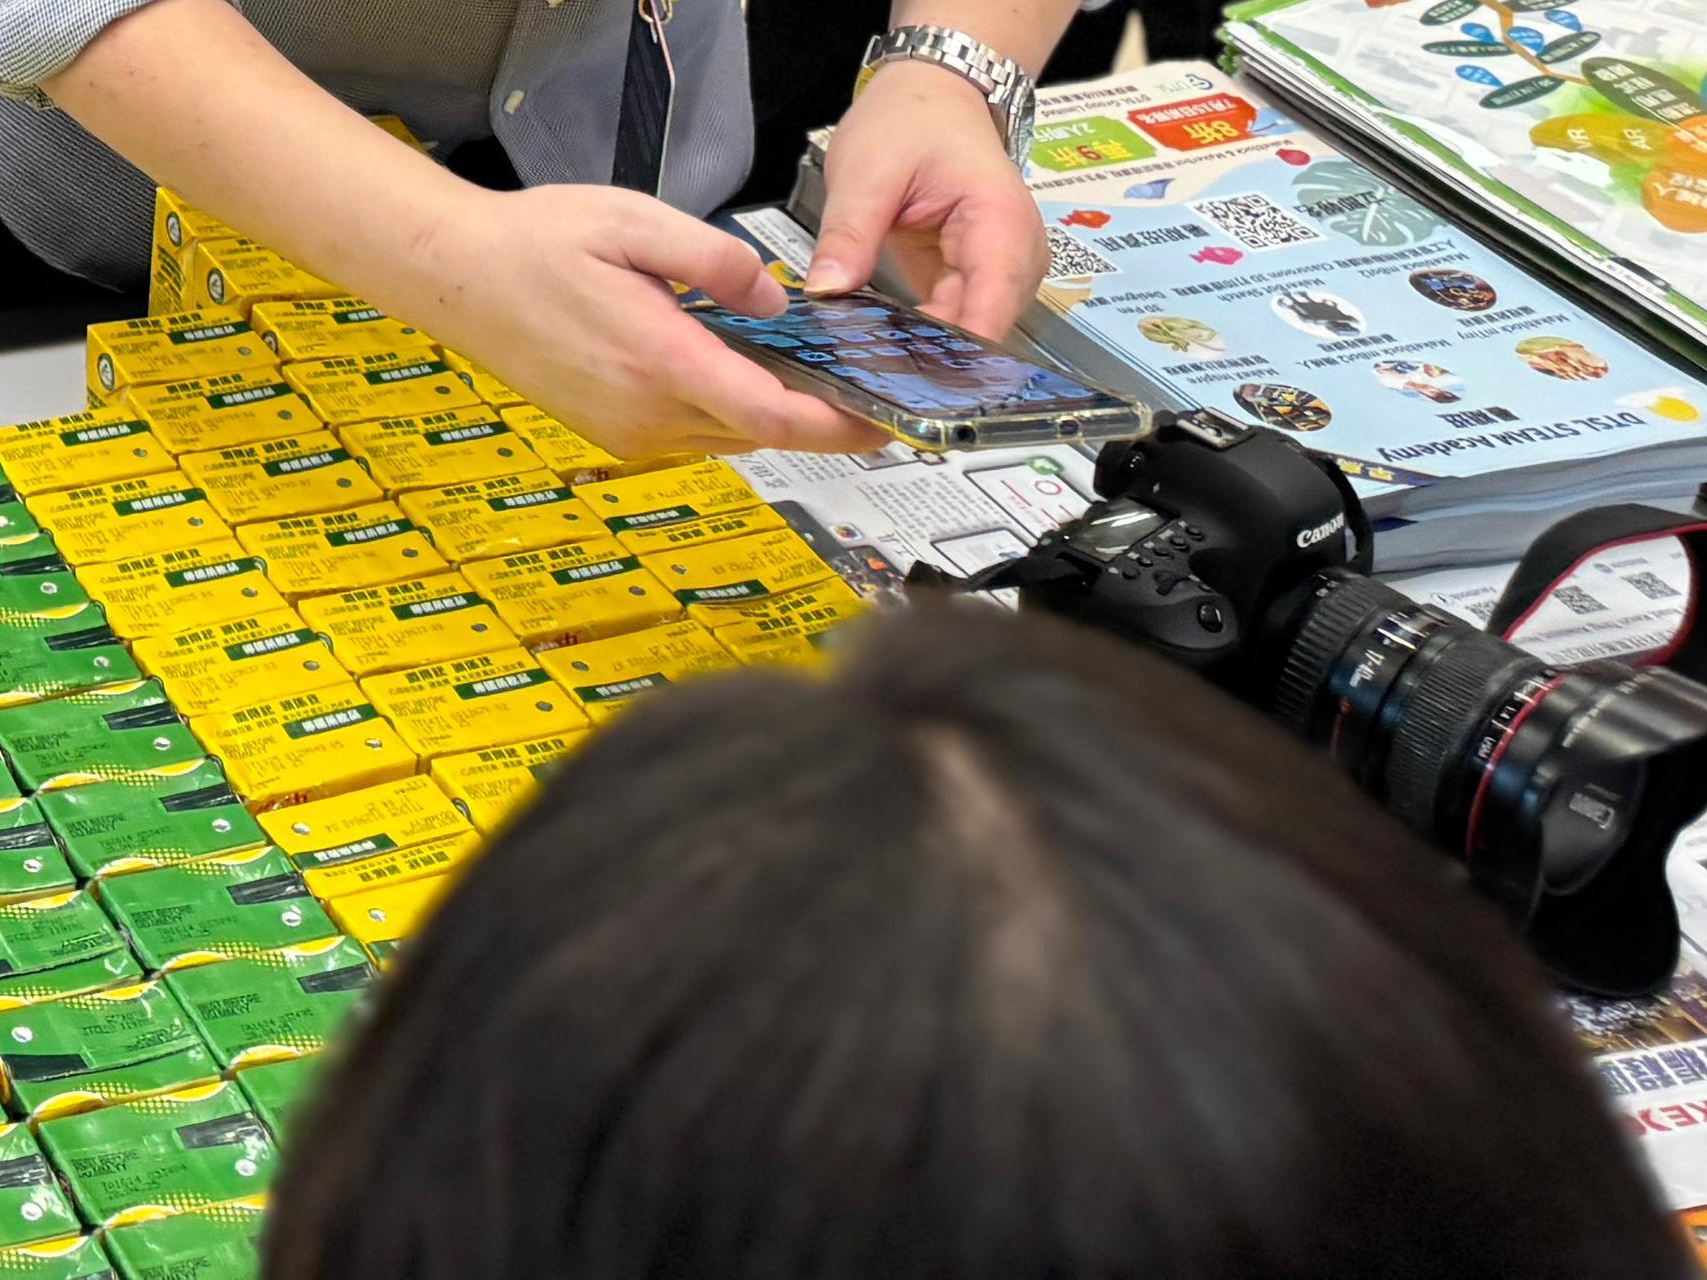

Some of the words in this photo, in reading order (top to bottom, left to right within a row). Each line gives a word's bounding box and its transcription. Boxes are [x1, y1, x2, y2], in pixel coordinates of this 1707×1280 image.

[1180, 120, 1240, 144] 8折
[1270, 260, 1334, 280] Classroom
[1581, 411, 1646, 430] DTSL
[1494, 422, 1580, 447] STEAM
[1375, 436, 1490, 463] Academy
[1296, 513, 1346, 550] Canon
